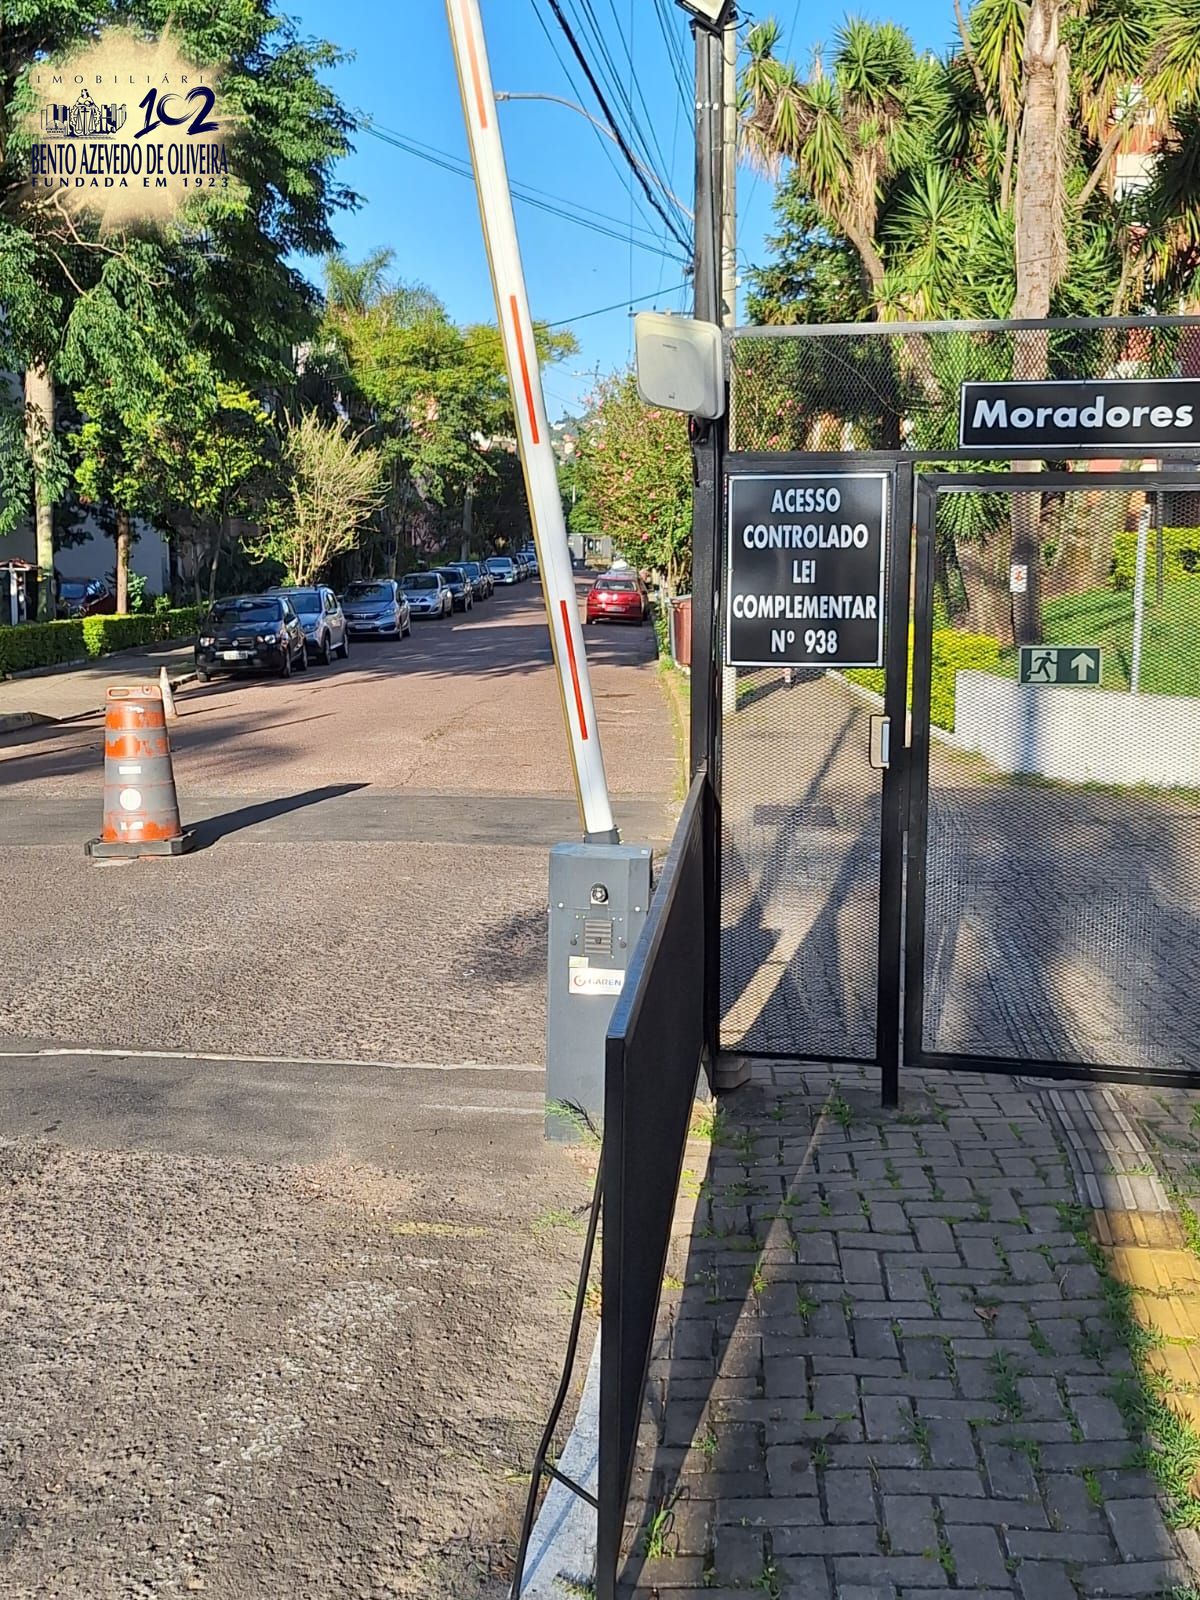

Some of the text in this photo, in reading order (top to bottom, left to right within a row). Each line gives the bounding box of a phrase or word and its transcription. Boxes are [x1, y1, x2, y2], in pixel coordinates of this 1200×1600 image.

[972, 396, 1193, 428] Moradores
[771, 488, 841, 513] ACESSO
[743, 524, 868, 549] CONTROLADO
[793, 560, 816, 583] LEI
[733, 595, 877, 619] COMPLEMENTAR
[804, 630, 838, 653] 938
